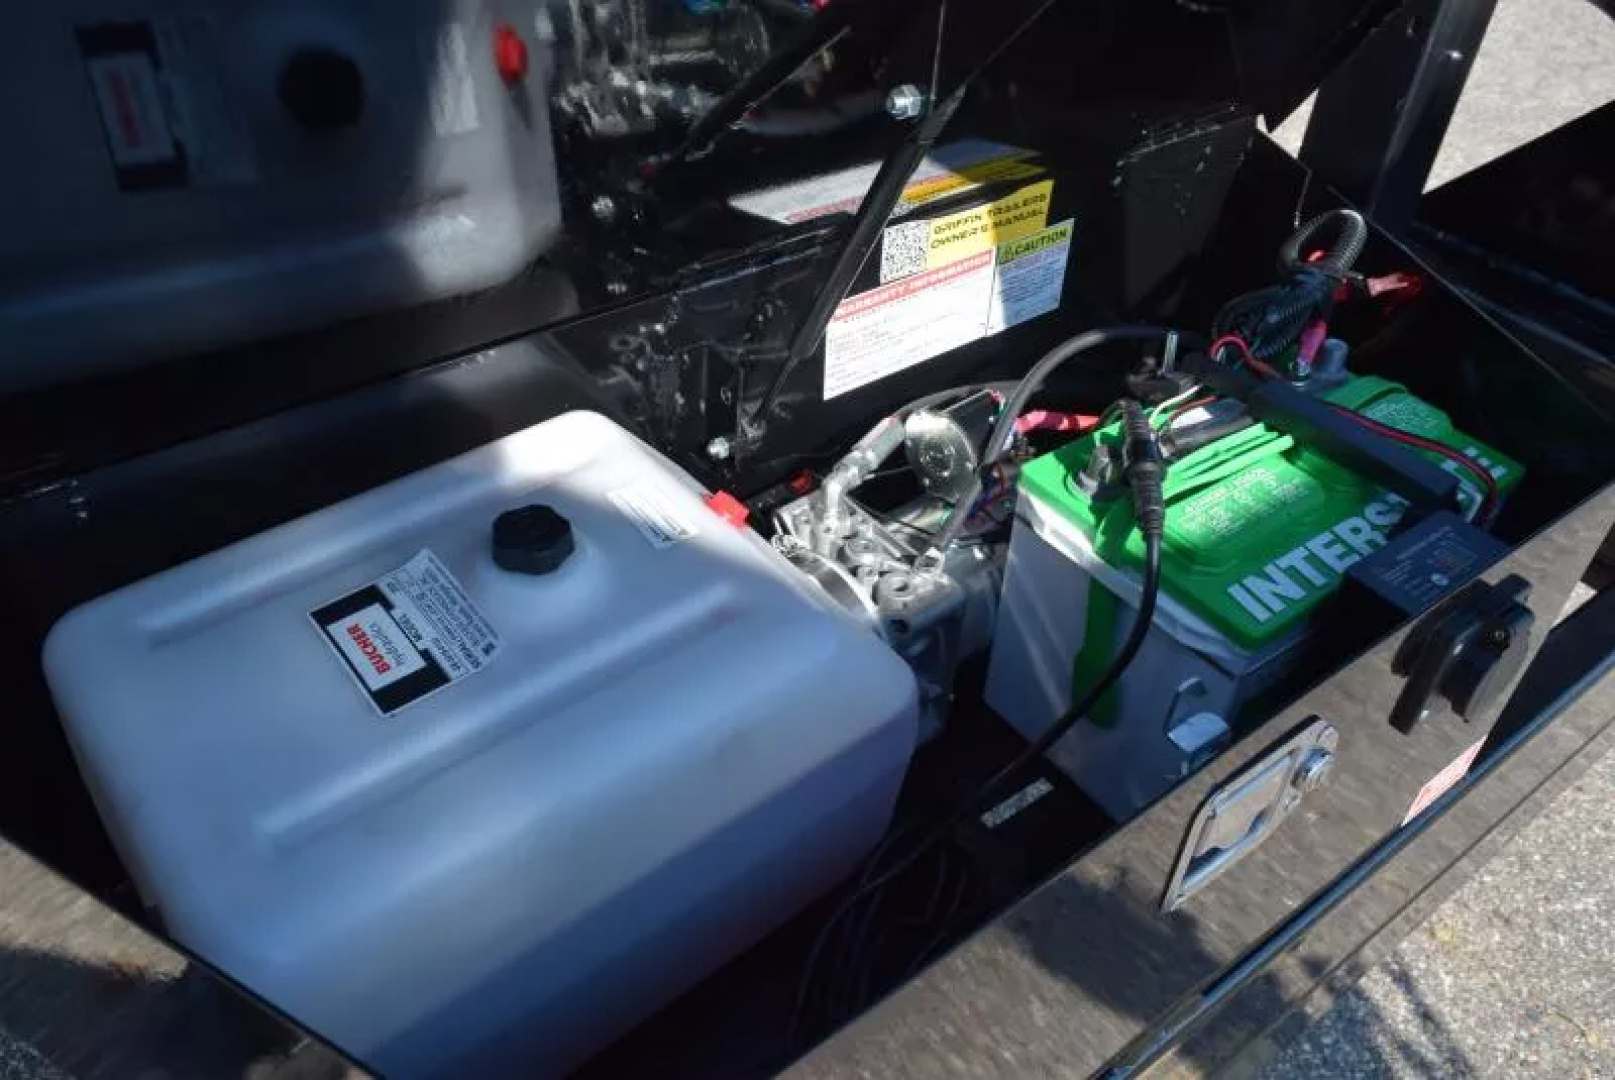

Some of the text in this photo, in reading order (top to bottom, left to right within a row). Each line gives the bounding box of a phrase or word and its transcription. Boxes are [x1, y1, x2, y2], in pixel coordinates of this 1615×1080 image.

[930, 207, 1044, 249] OWNER'S MANUAL
[934, 193, 1048, 235] GRIFFIN TRAILERS
[1015, 227, 1067, 254] CAUTION
[346, 622, 391, 675] BUCHER
